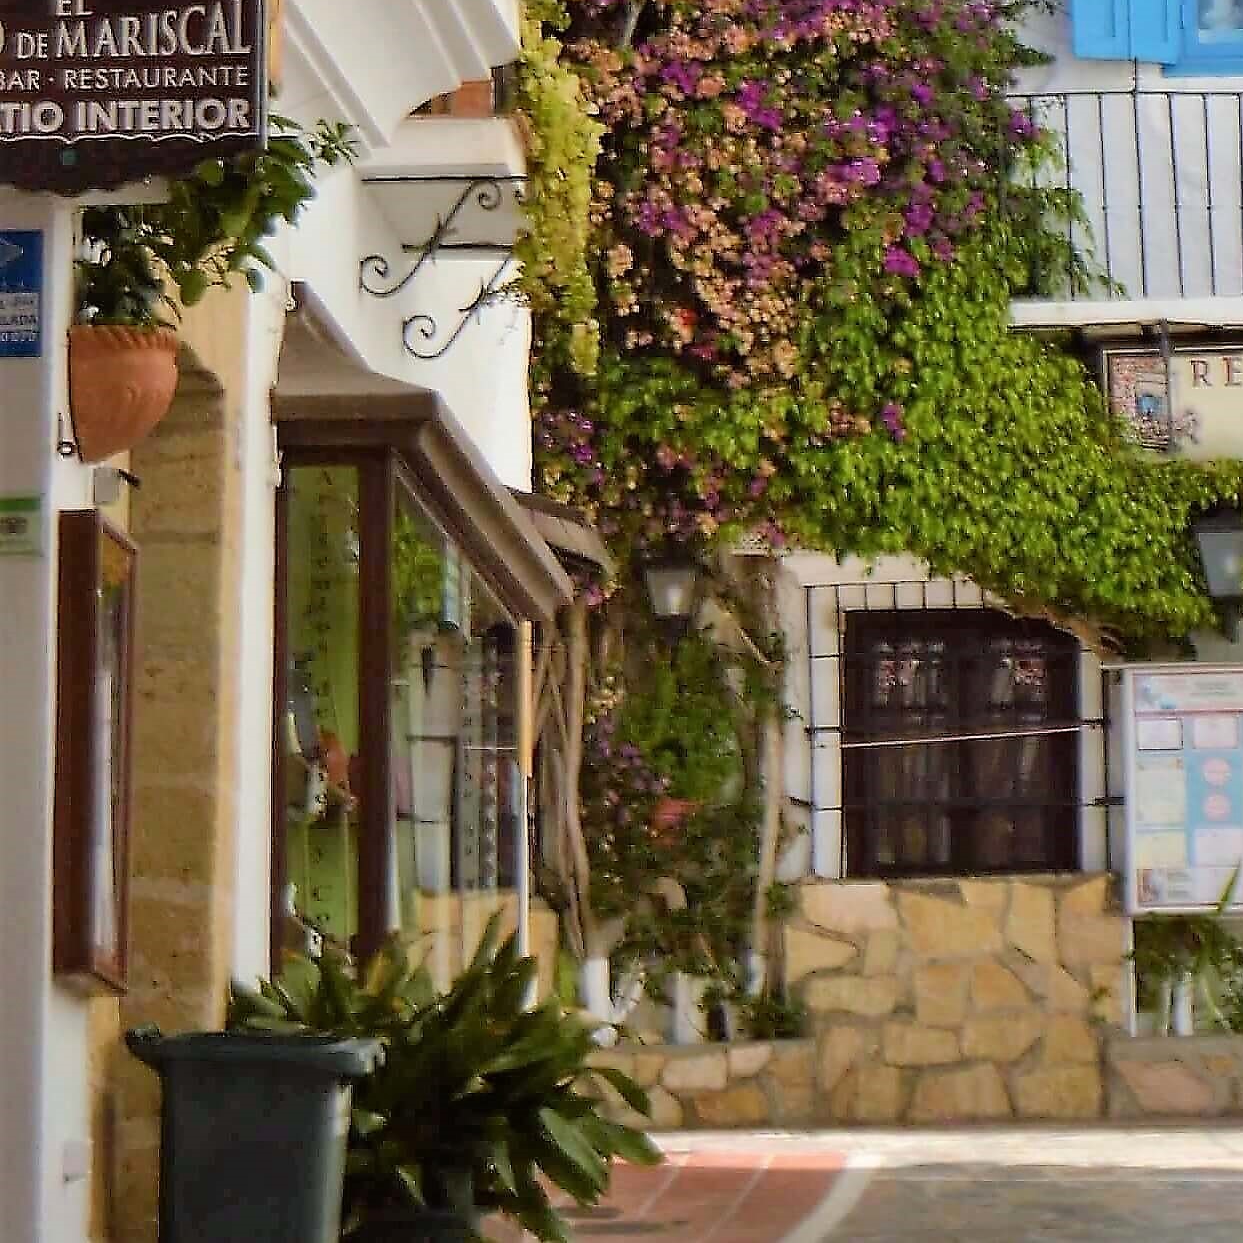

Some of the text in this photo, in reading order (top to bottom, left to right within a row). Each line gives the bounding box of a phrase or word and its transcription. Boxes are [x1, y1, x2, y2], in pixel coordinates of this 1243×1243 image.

[16, 32, 48, 59] DE
[64, 67, 249, 91] RESTAURANTE
[75, 98, 250, 133] INTERIOR
